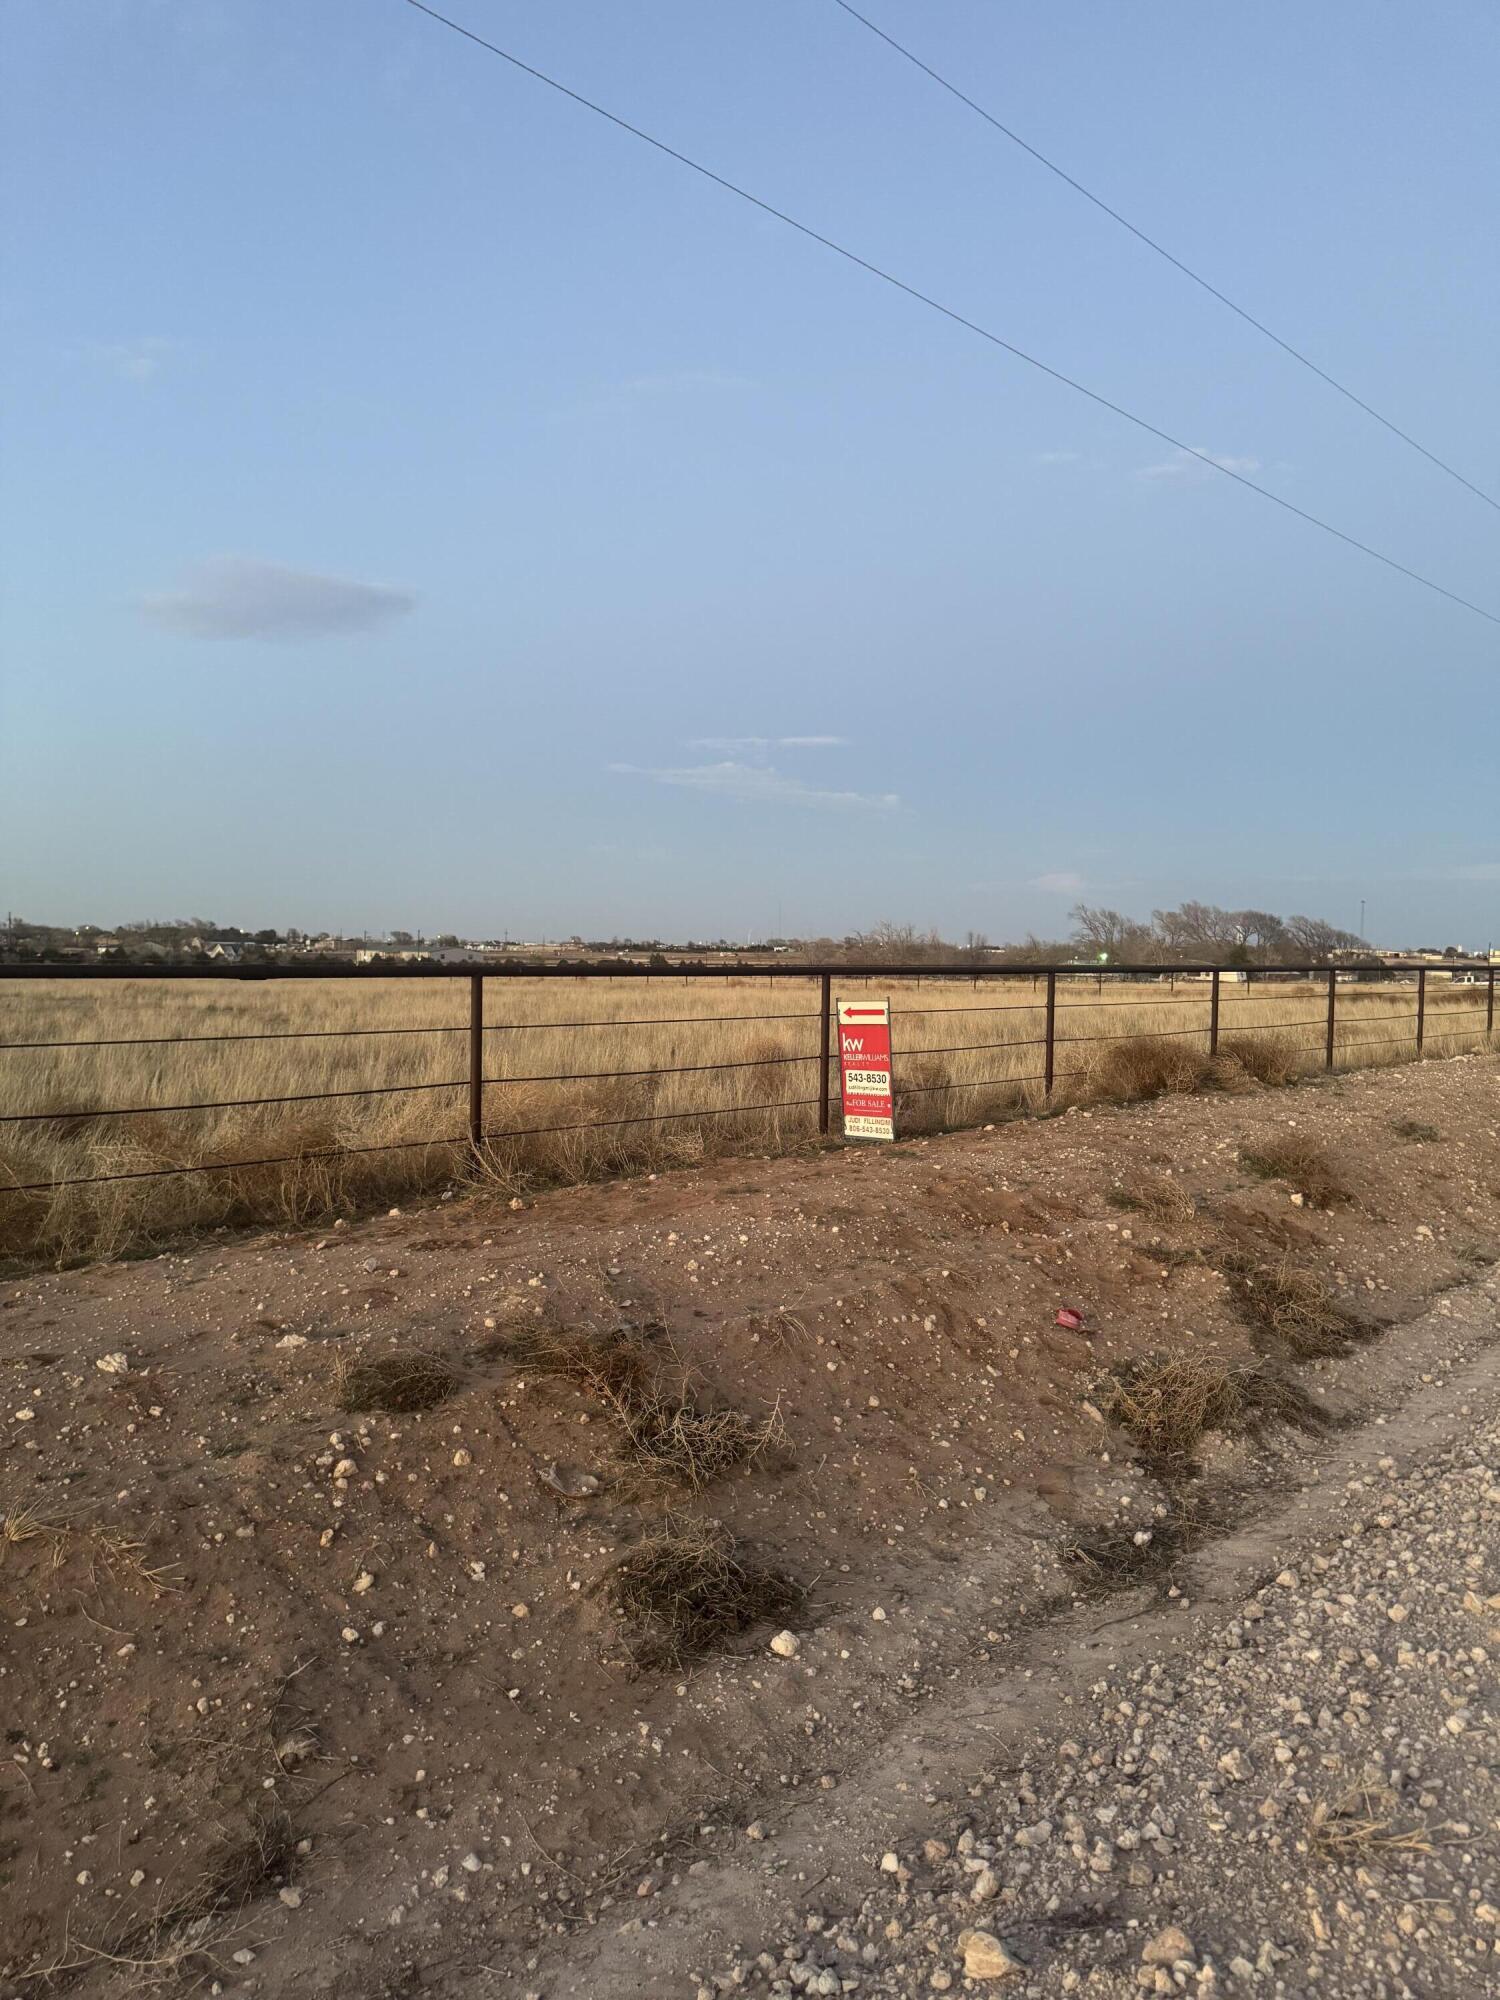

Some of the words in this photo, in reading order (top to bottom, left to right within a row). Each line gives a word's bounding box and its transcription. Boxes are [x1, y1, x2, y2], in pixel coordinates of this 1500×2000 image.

[848, 1072, 887, 1084] 543-8530
[852, 1099, 866, 1107] FOR
[867, 1100, 885, 1108] SALE
